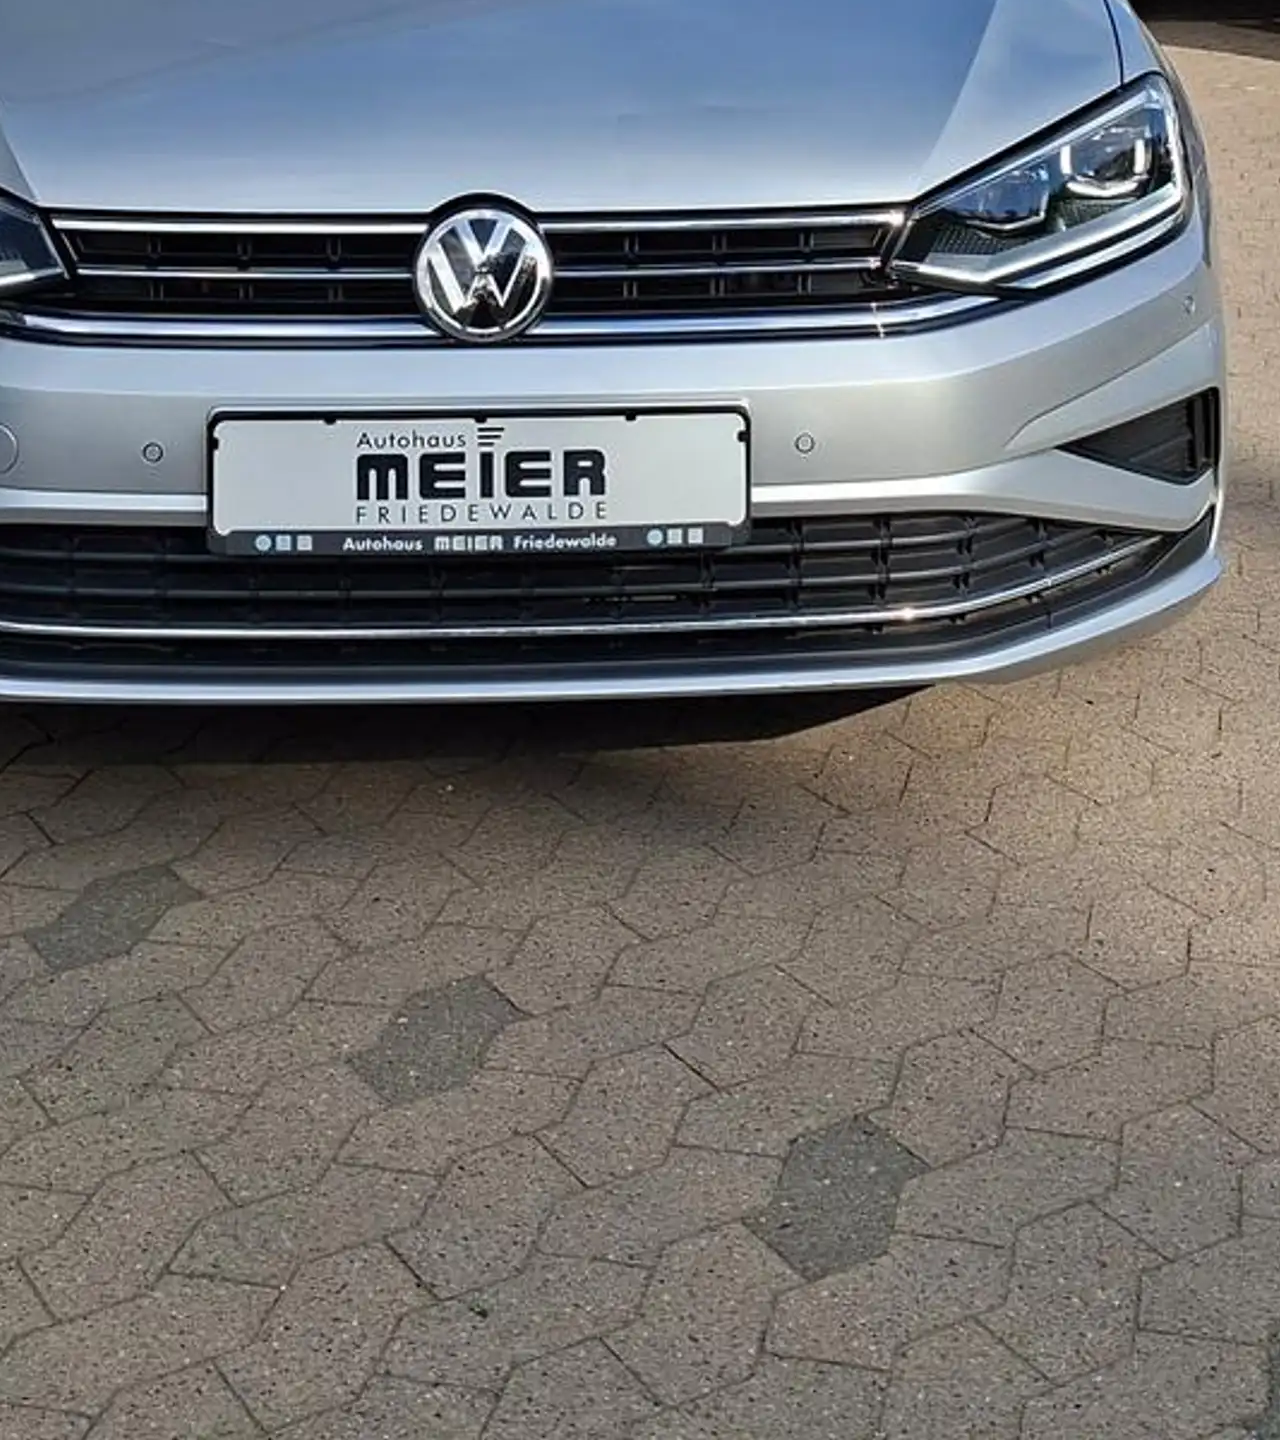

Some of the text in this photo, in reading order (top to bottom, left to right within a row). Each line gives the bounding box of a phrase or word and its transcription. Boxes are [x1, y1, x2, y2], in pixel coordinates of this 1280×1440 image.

[356, 430, 466, 449] Autohaus
[356, 448, 606, 500] MEIER
[356, 501, 607, 524] FRIEDEWALDE
[342, 532, 618, 552] Autohaus MEIER Friedewalde
